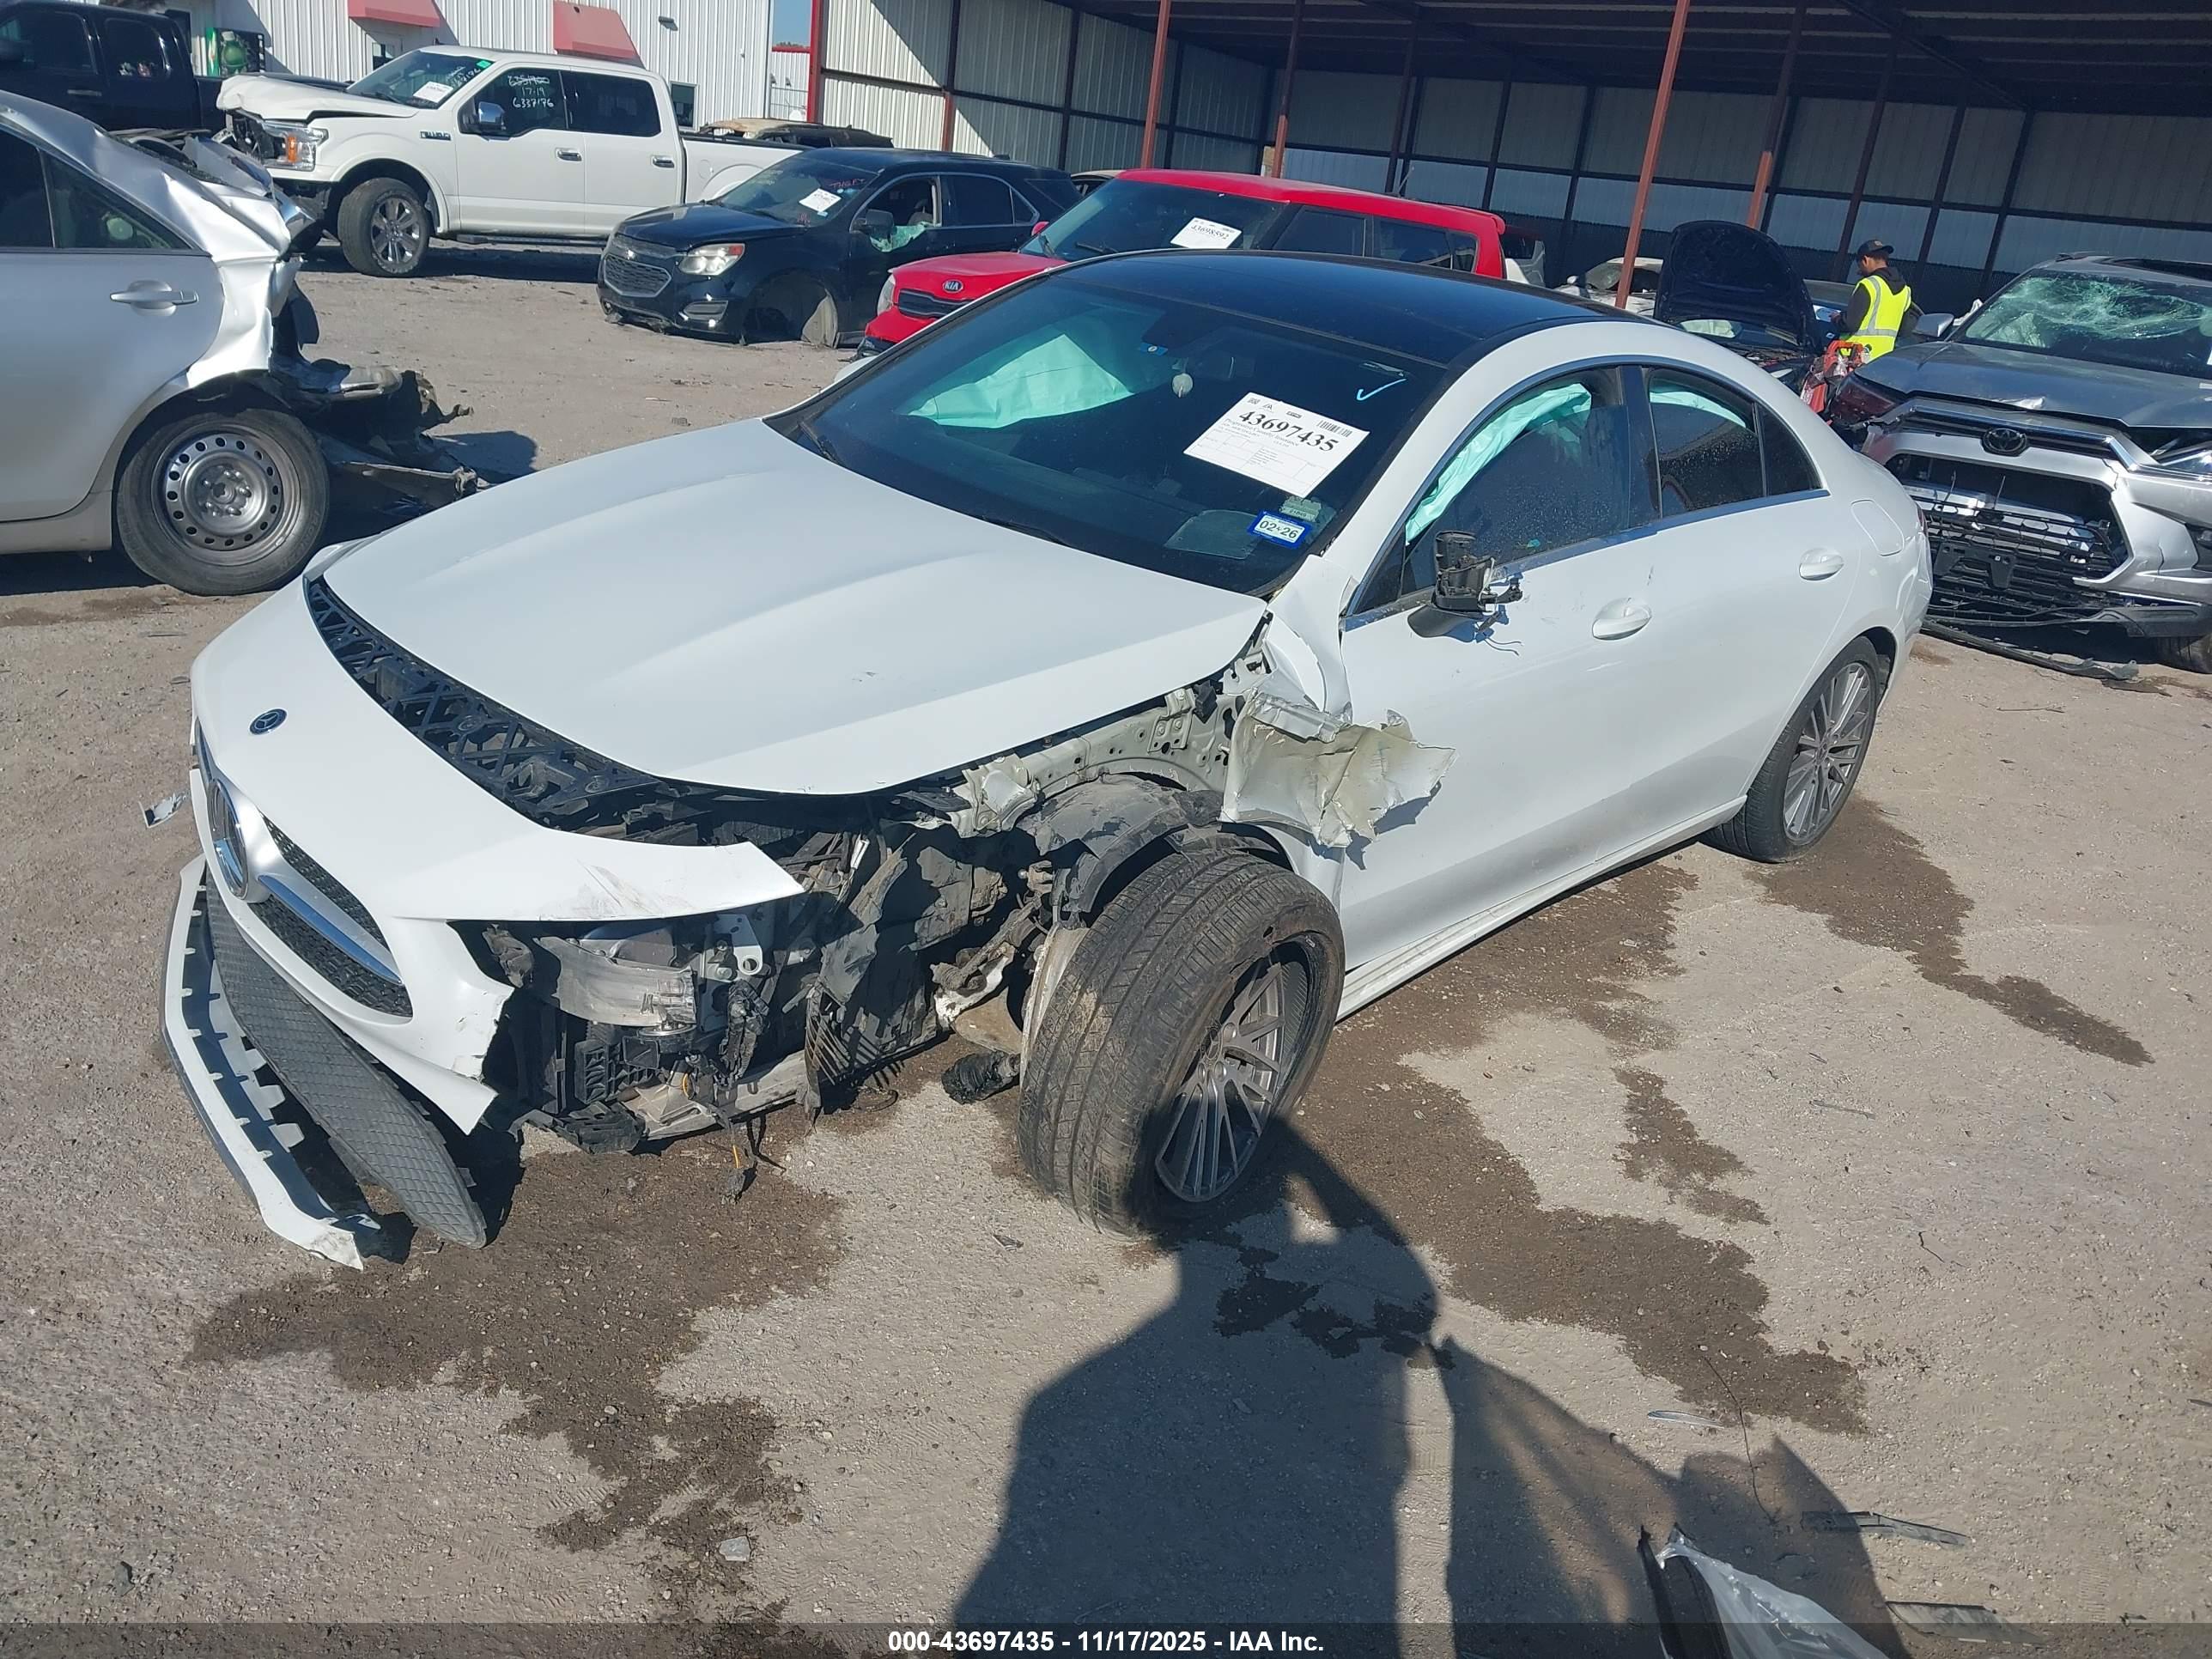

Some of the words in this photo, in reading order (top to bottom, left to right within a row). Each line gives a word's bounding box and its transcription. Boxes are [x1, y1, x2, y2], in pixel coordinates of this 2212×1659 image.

[512, 97, 555, 108] 6337176
[945, 280, 959, 291] KIA
[1238, 411, 1340, 452] 43697435
